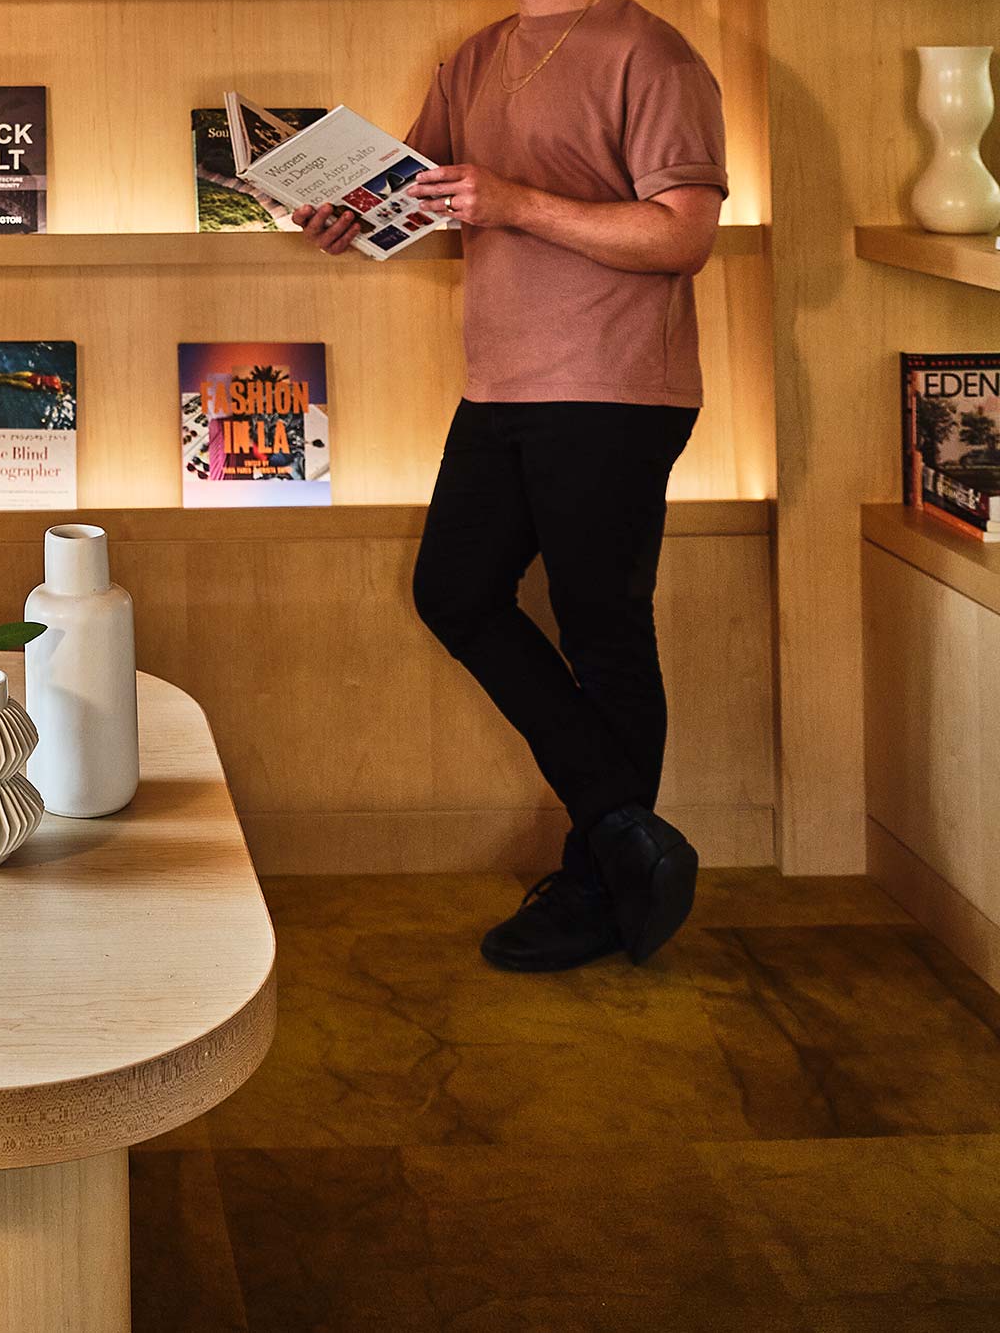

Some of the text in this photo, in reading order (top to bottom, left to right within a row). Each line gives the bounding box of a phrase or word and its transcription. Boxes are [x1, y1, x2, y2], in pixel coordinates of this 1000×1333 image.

[208, 127, 229, 138] Sou
[265, 152, 307, 178] Women
[280, 155, 327, 187] in Design
[296, 178, 326, 197] From
[347, 144, 376, 165] Aalto
[310, 195, 323, 205] to
[924, 372, 1000, 397] EDEN
[200, 381, 310, 416] FASHION
[223, 420, 291, 454] IN LA
[12, 445, 48, 460] Blind
